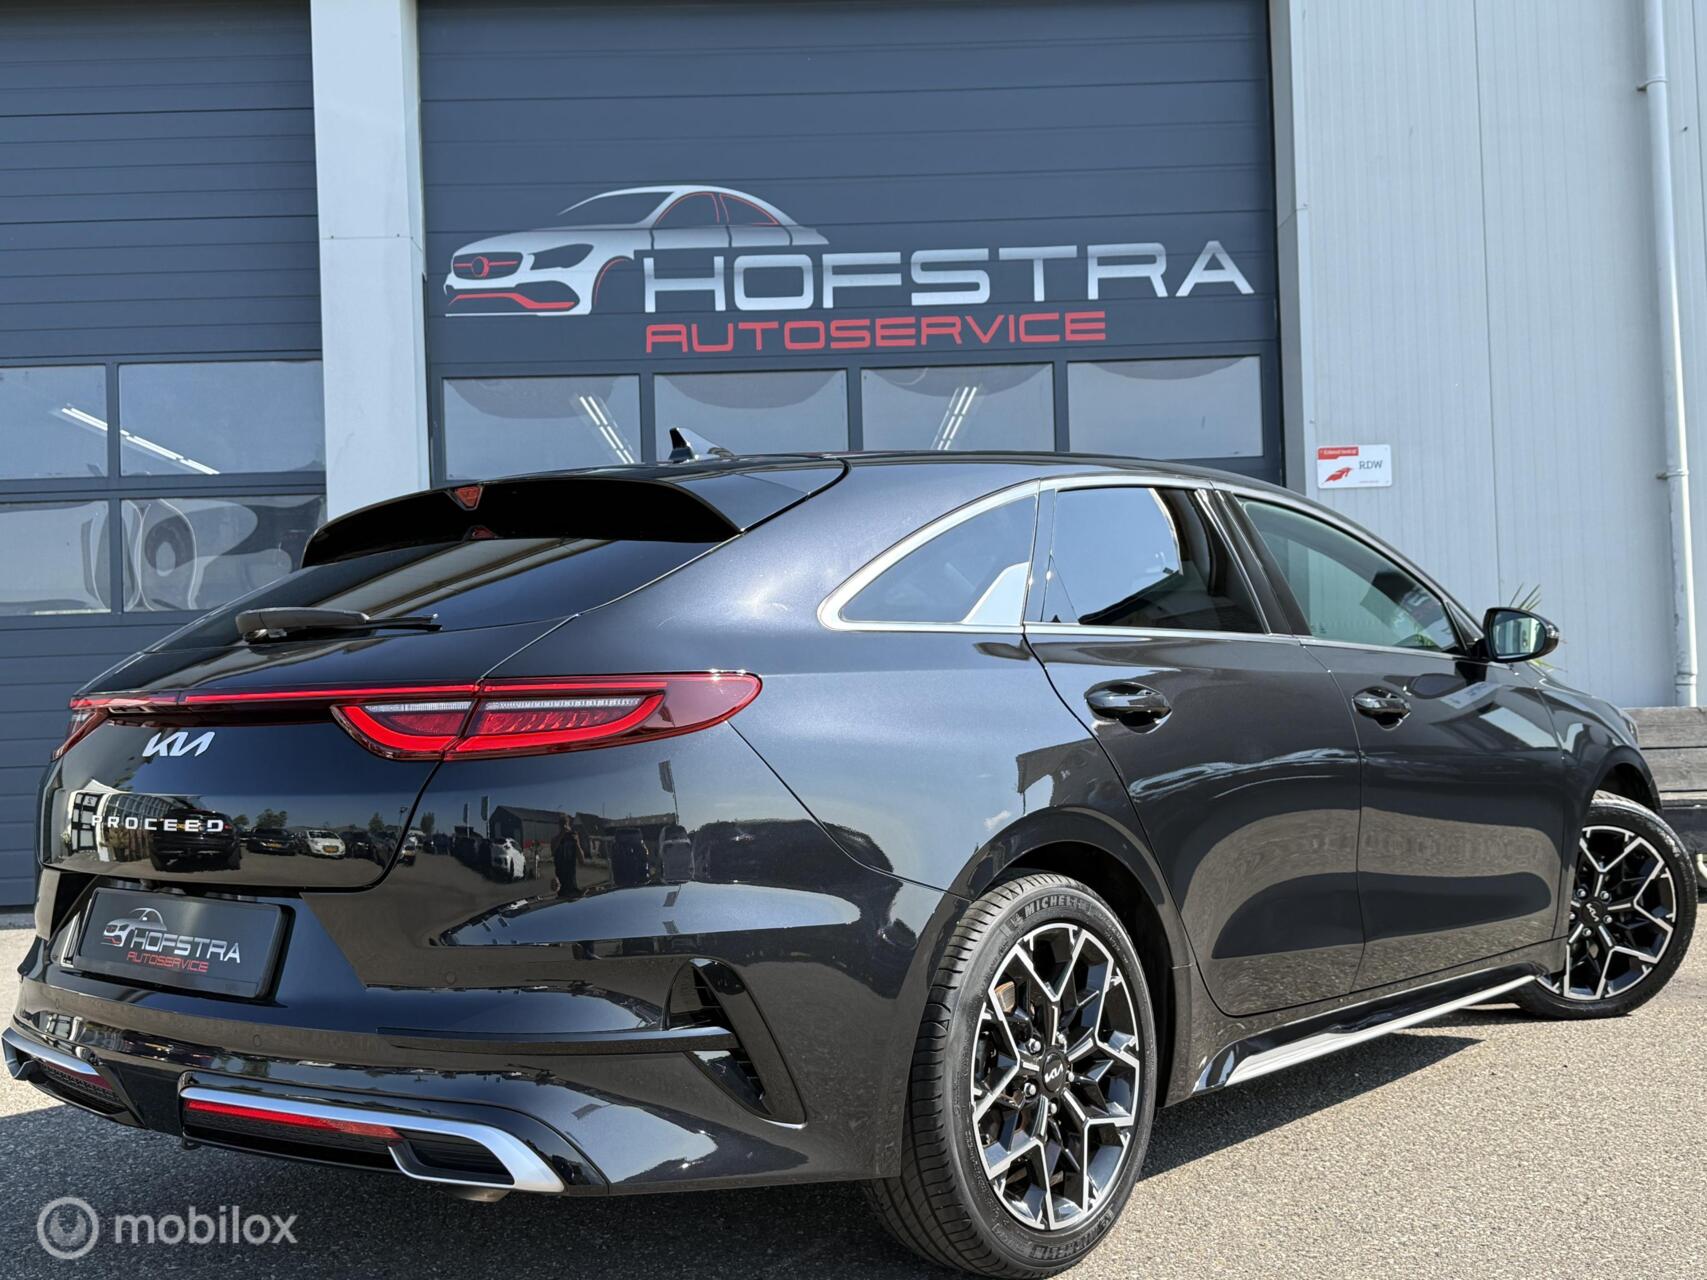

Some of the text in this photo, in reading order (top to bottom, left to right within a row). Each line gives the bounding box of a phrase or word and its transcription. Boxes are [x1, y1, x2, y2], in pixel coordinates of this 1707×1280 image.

[644, 240, 1255, 313] HOFSTRA
[645, 311, 1106, 353] AUTOSERVICE
[1359, 460, 1383, 470] RDW
[142, 731, 215, 757] KIA
[91, 815, 224, 833] PROCEED
[130, 929, 241, 963] HOFSTRA
[127, 951, 209, 972] AUTOSERVICE
